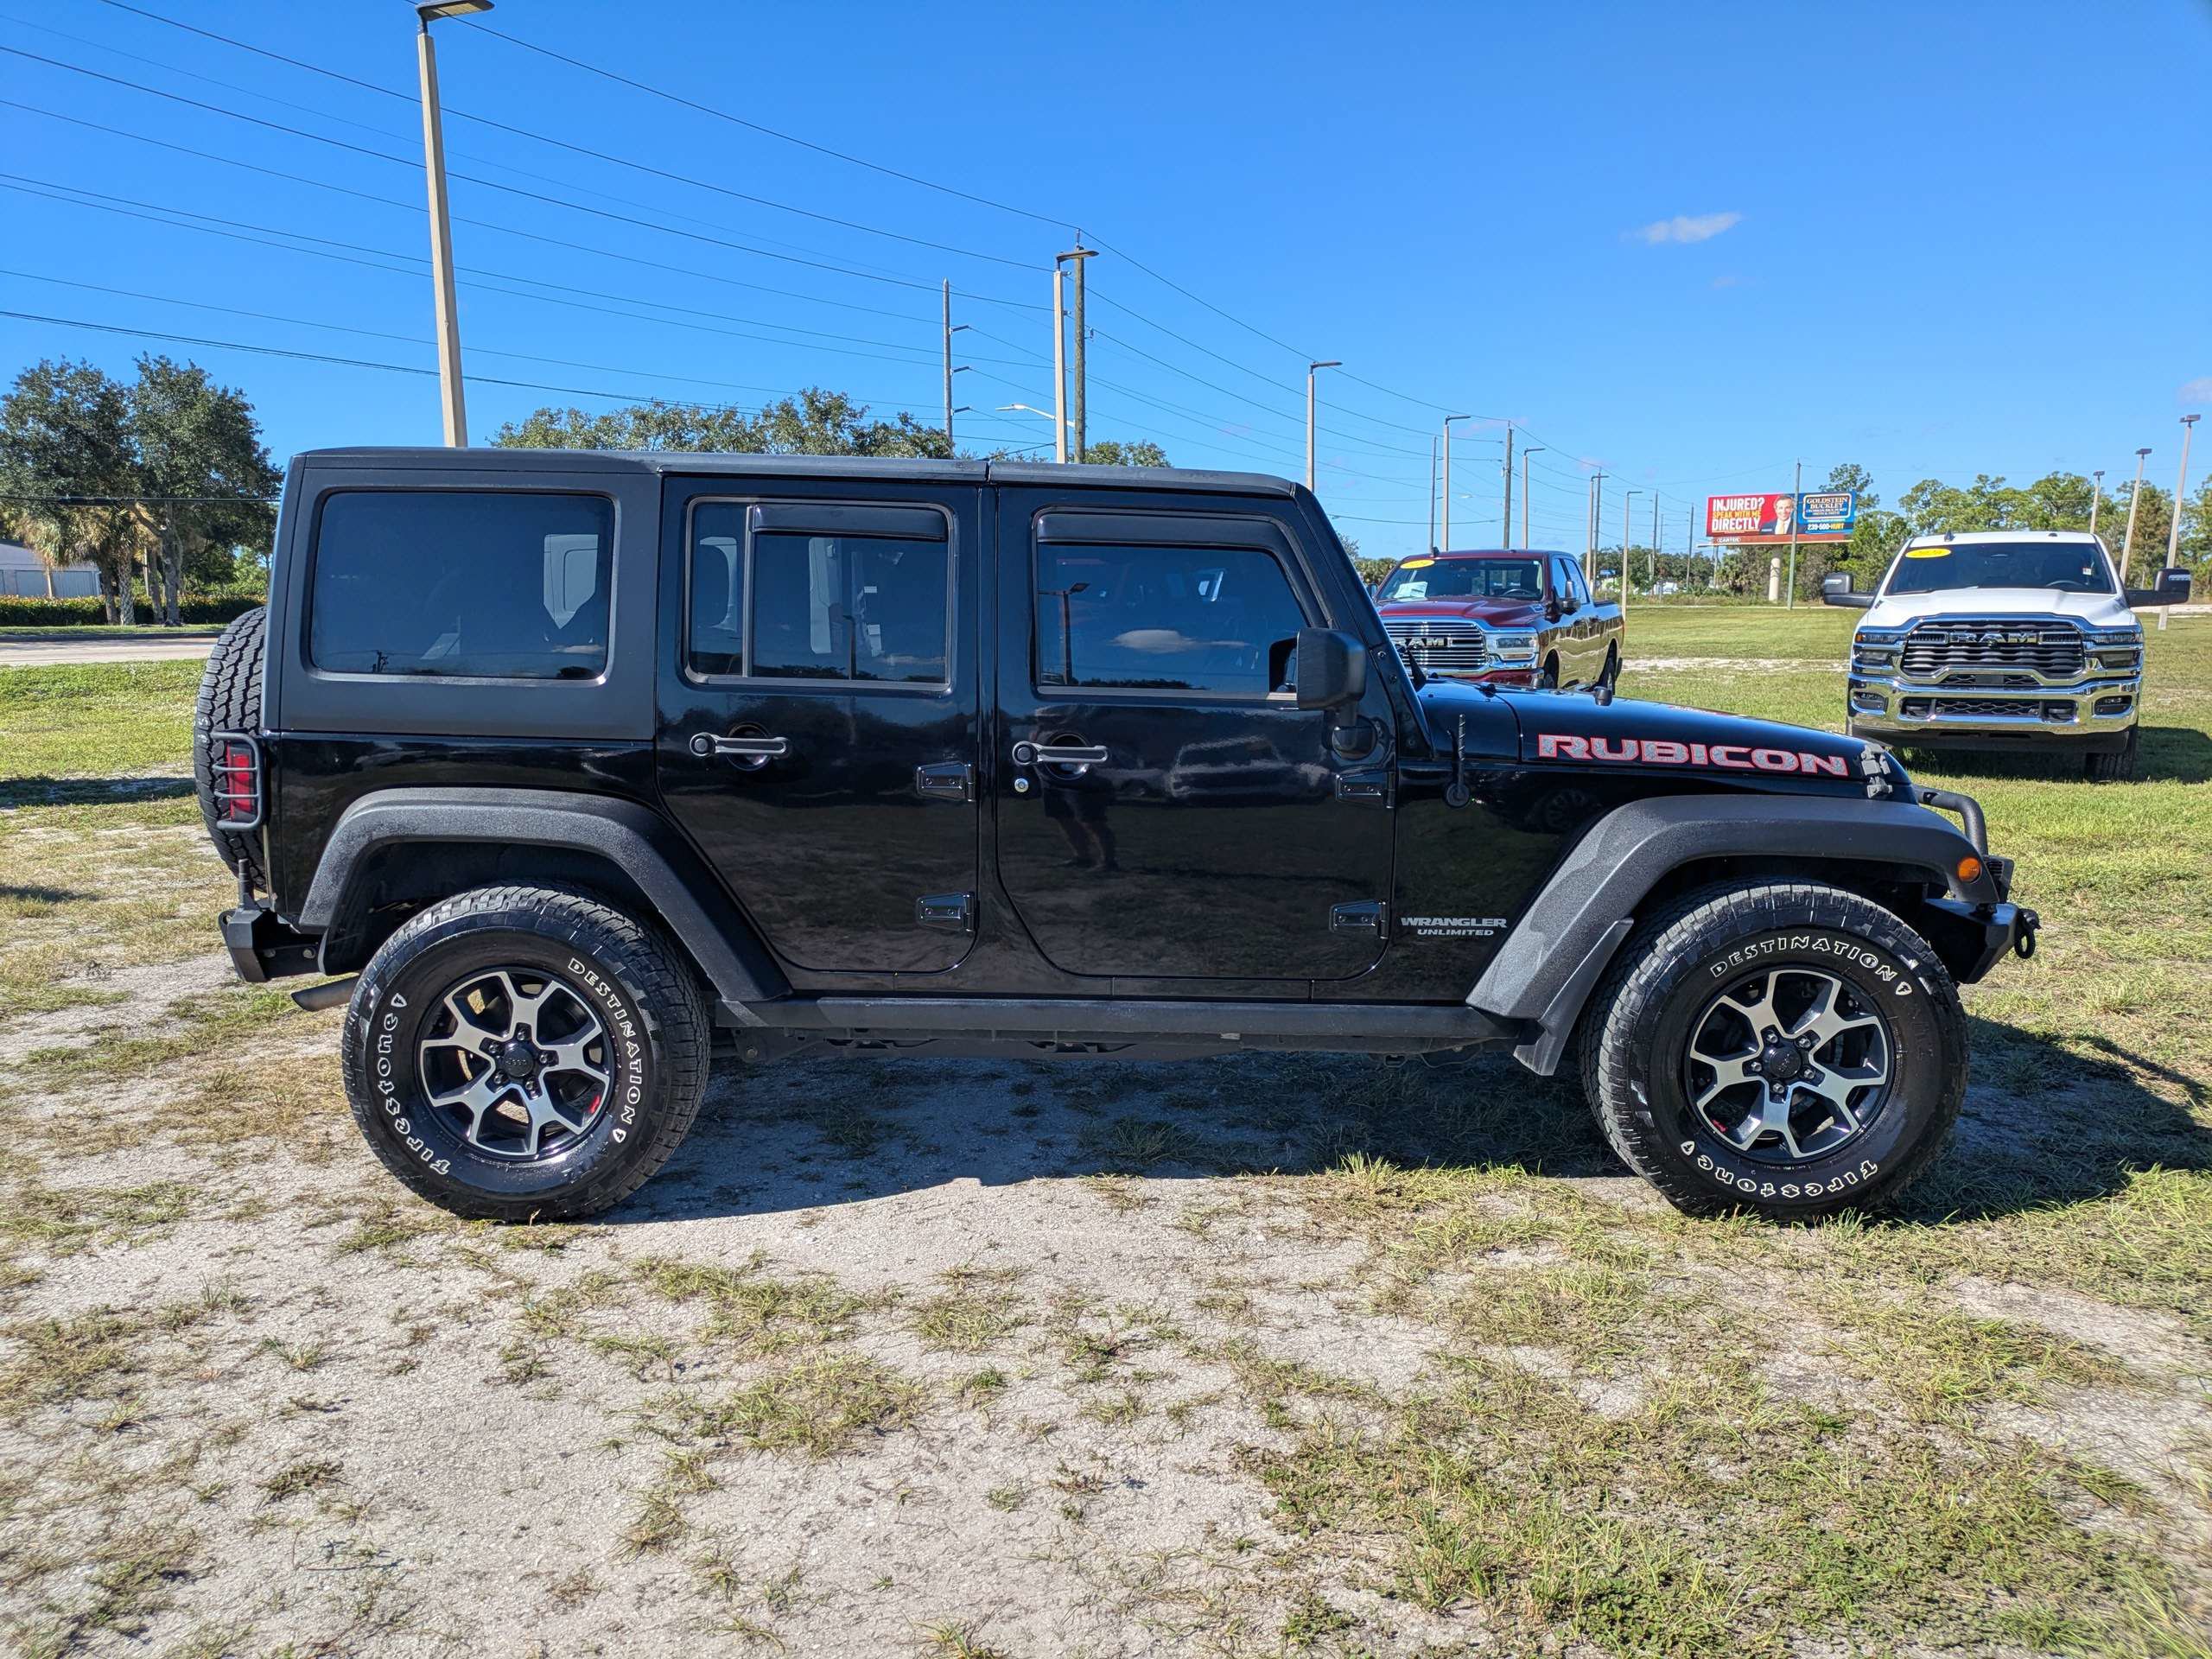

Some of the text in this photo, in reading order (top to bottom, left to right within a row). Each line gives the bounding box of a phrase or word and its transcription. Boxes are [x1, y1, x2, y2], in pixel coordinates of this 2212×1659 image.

[1713, 497, 1765, 512] INJURED?
[1711, 517, 1761, 531] DIRECTLY
[1390, 637, 1445, 649] RAM
[1949, 631, 2037, 644] RAM
[1537, 733, 1850, 777] RUBICON
[1400, 917, 1508, 928] WRANGLER
[1710, 936, 1898, 982] DESTINATION
[567, 957, 644, 1126] DESTINATION
[378, 1012, 453, 1175] Firestone
[1696, 1154, 1879, 1198] Firestone
